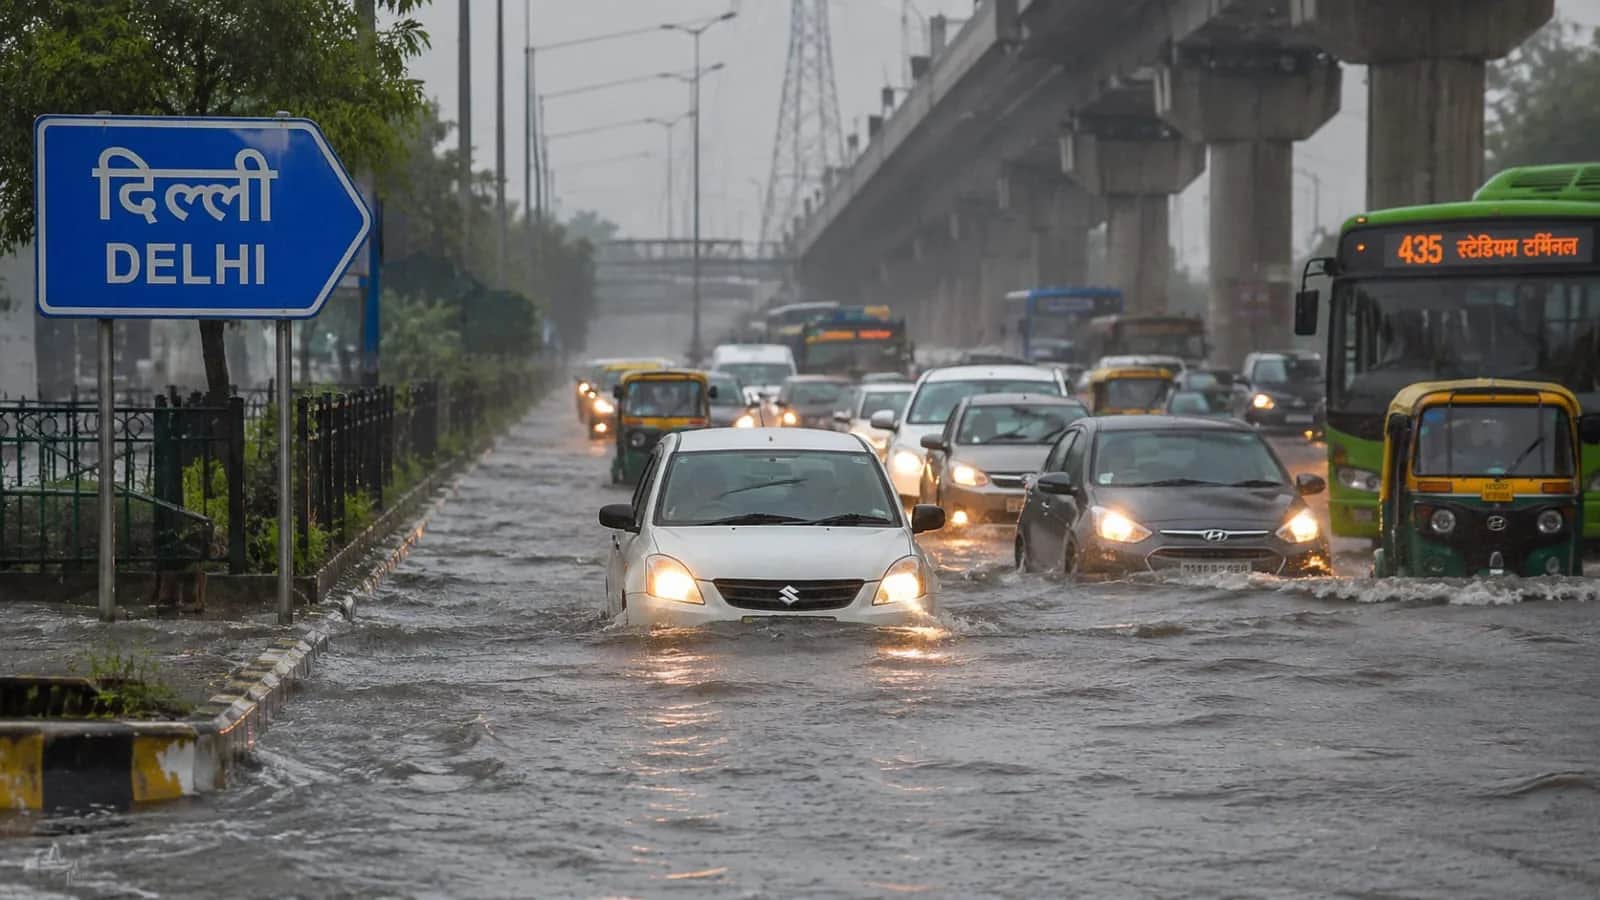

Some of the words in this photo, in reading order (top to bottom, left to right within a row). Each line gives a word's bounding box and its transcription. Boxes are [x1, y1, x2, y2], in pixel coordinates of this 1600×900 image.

[92, 146, 279, 224] दिल्ली
[106, 242, 265, 285] DELHI
[1398, 234, 1443, 264] 435
[1456, 234, 1519, 260] स्टेडियम
[1523, 232, 1579, 257] टर्मिनल
